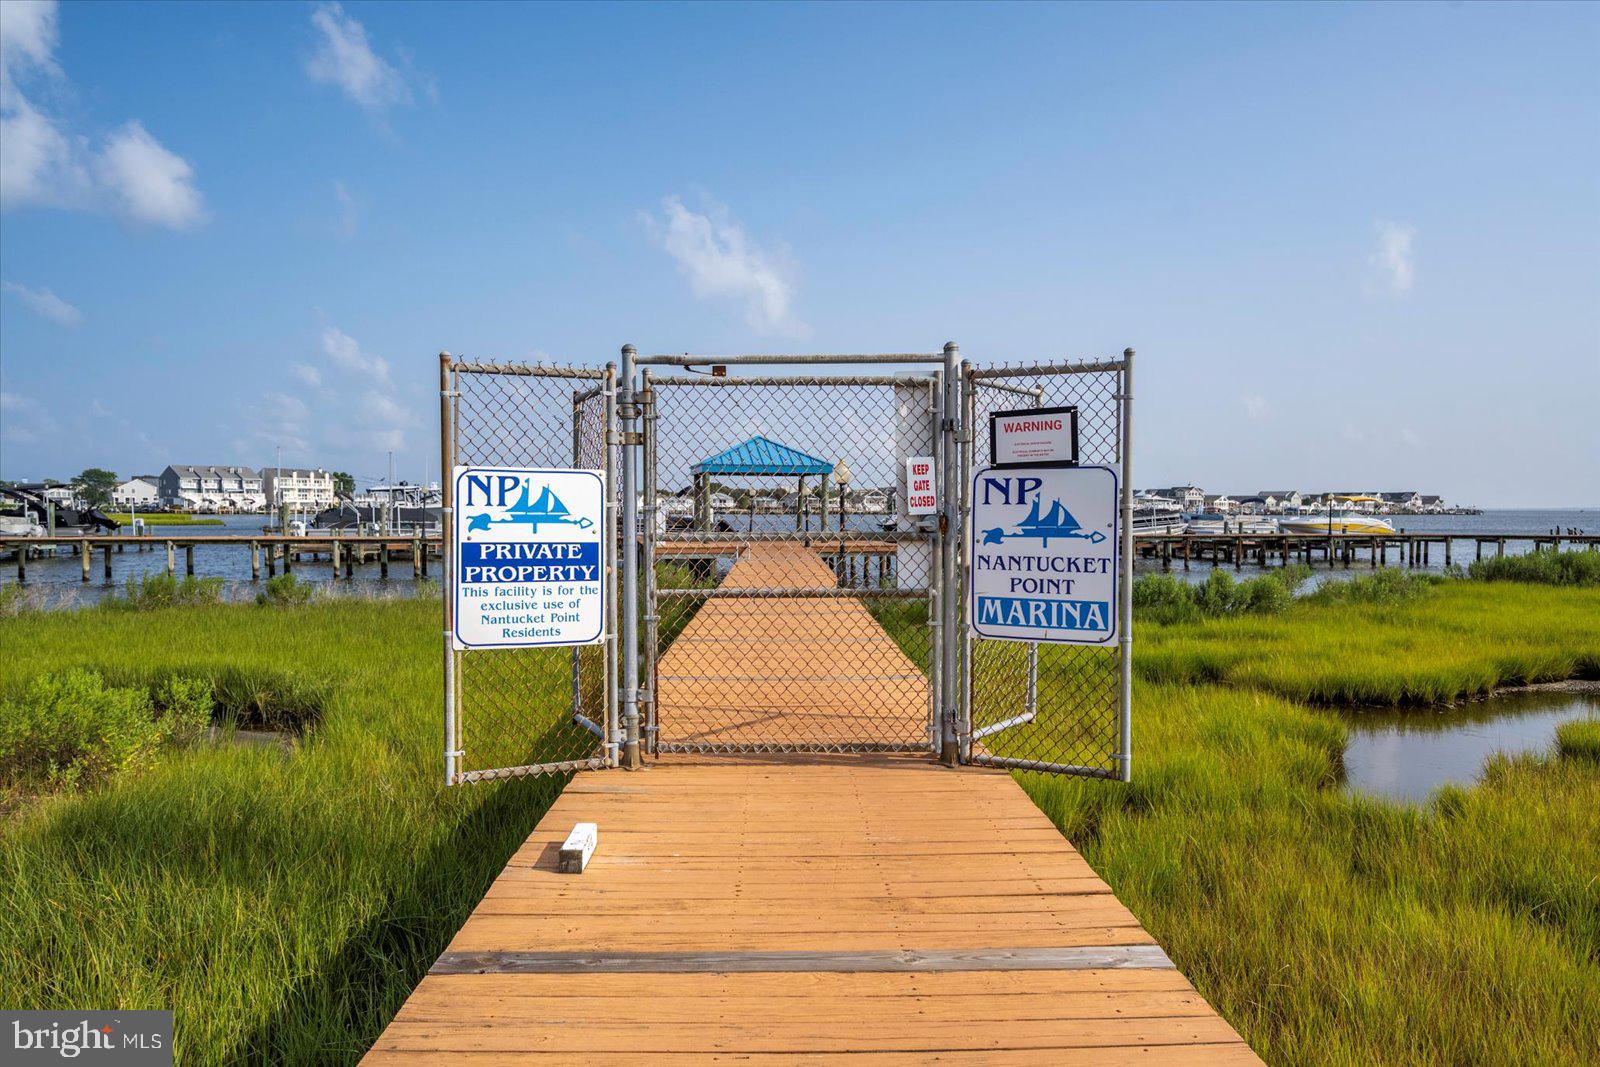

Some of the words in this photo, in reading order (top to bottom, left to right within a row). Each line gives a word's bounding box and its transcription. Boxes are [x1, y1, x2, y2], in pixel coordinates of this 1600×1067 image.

[1003, 419, 1063, 434] WARNING
[912, 463, 930, 476] KEEP
[465, 475, 521, 507] NP
[913, 480, 930, 492] GATE
[982, 477, 1043, 505] NP
[909, 495, 935, 508] CLOSED
[479, 543, 583, 560] PRIVATE
[977, 555, 1112, 574] NANTUCKET
[464, 565, 596, 583] PROPERTY
[462, 586, 489, 598] This
[494, 586, 537, 599] facility
[542, 586, 553, 596] is
[557, 585, 575, 596] for
[580, 585, 599, 595] the
[1010, 577, 1075, 595] POINT
[480, 600, 538, 611] exclusive
[543, 601, 564, 610] use
[568, 598, 581, 609] of
[480, 613, 545, 625] Nantucket
[550, 612, 580, 623] Point
[980, 598, 1107, 630] MARINA
[502, 627, 561, 639] Residents
